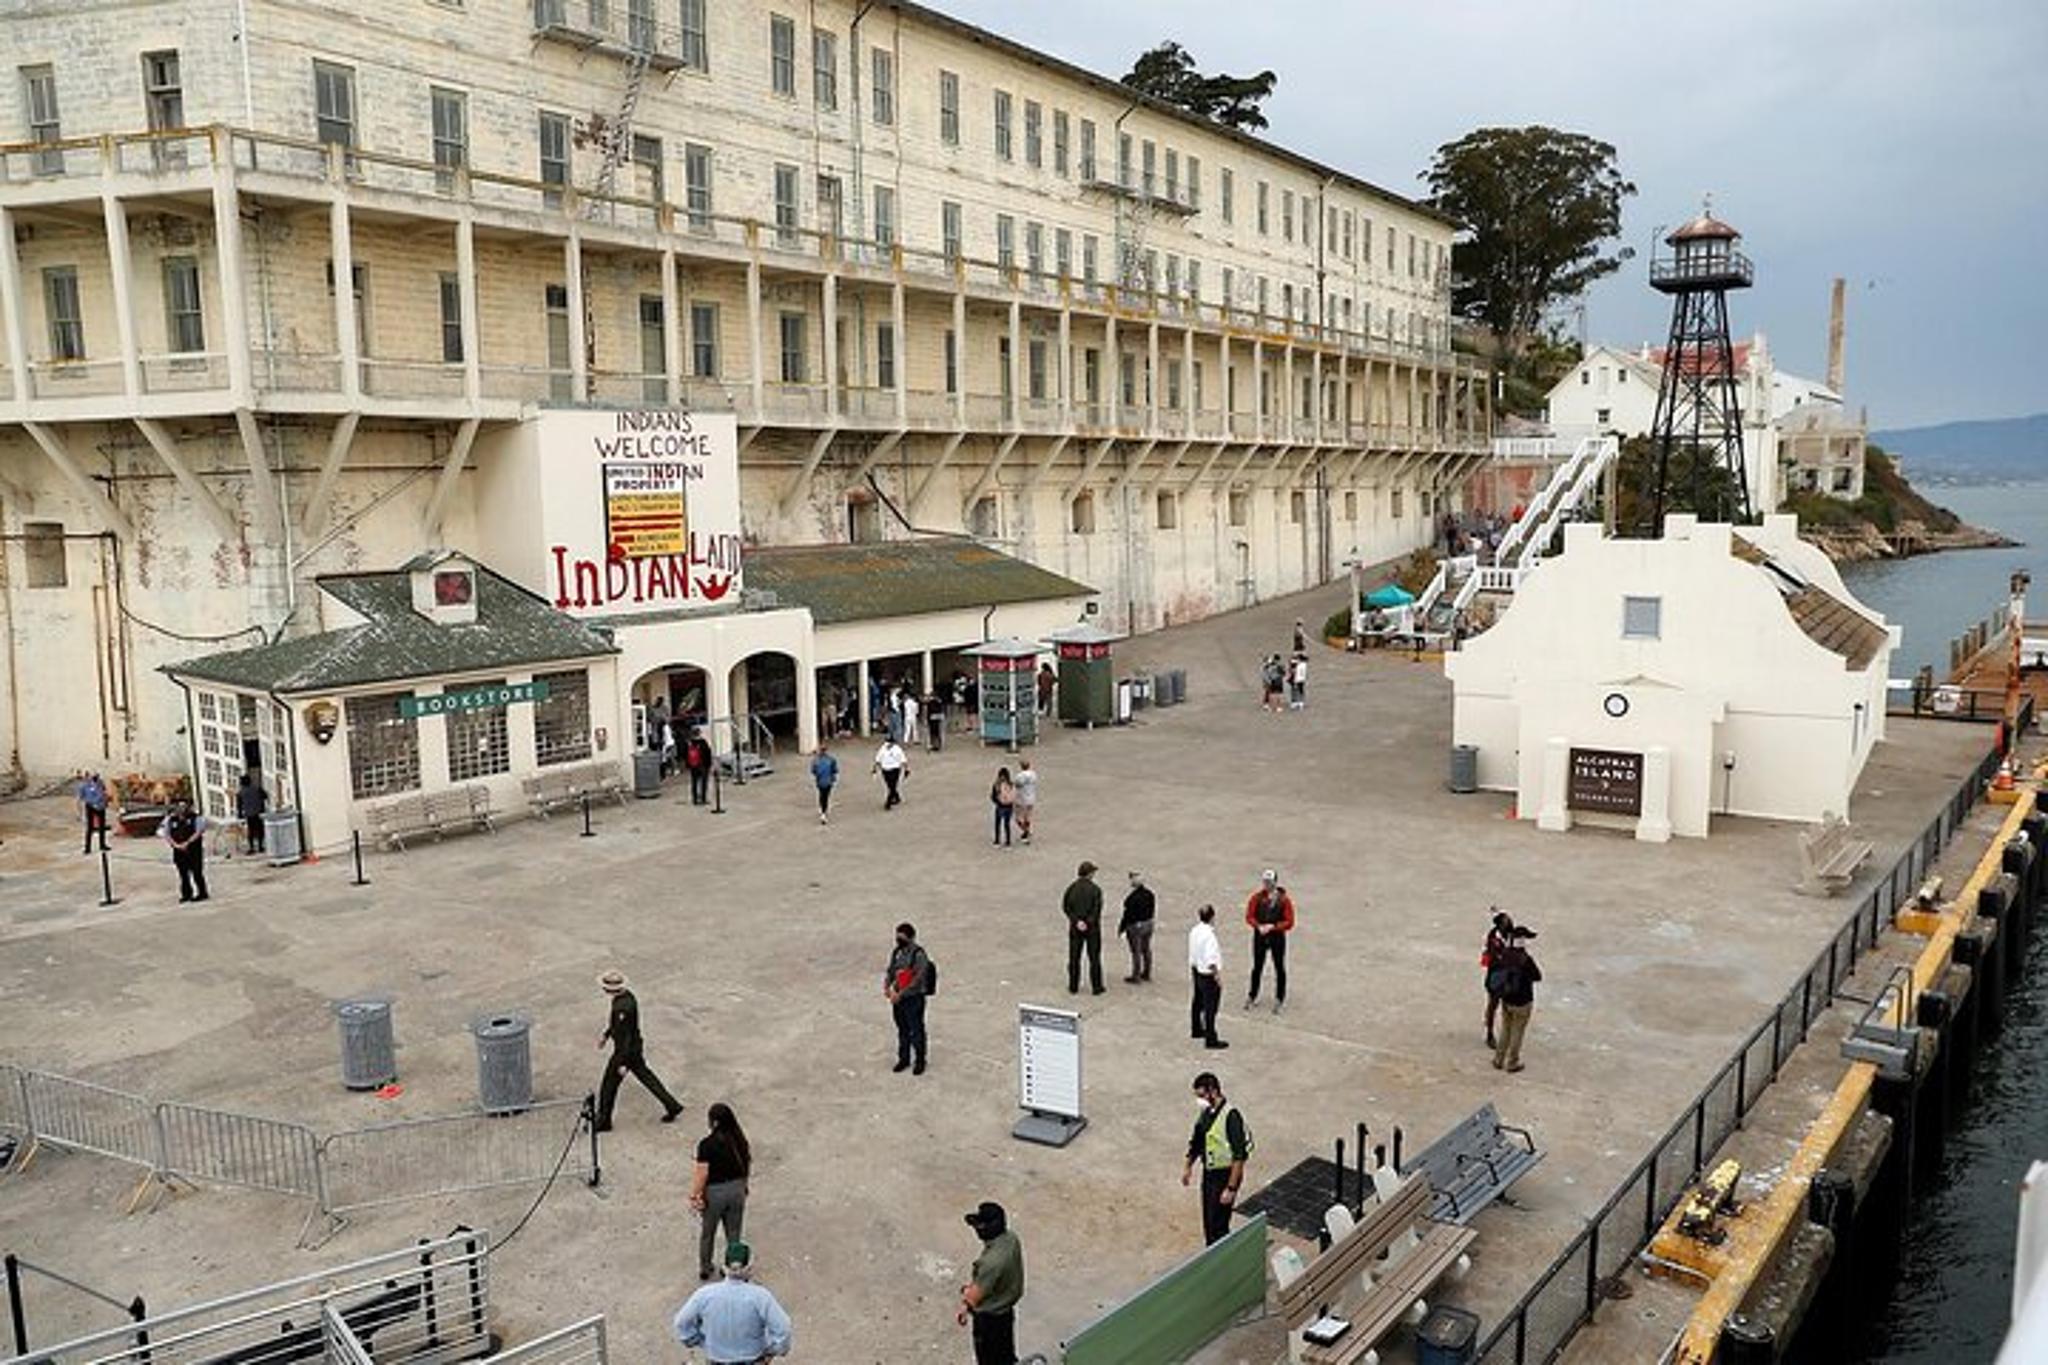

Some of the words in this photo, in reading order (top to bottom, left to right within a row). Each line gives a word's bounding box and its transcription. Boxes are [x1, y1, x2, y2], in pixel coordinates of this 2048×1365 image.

[616, 412, 692, 434] INDIANS
[594, 435, 712, 459] WELCOME
[614, 480, 676, 490] PROPERTY
[416, 687, 535, 713] BOOKSTORE
[1575, 766, 1637, 780] ISLAND
